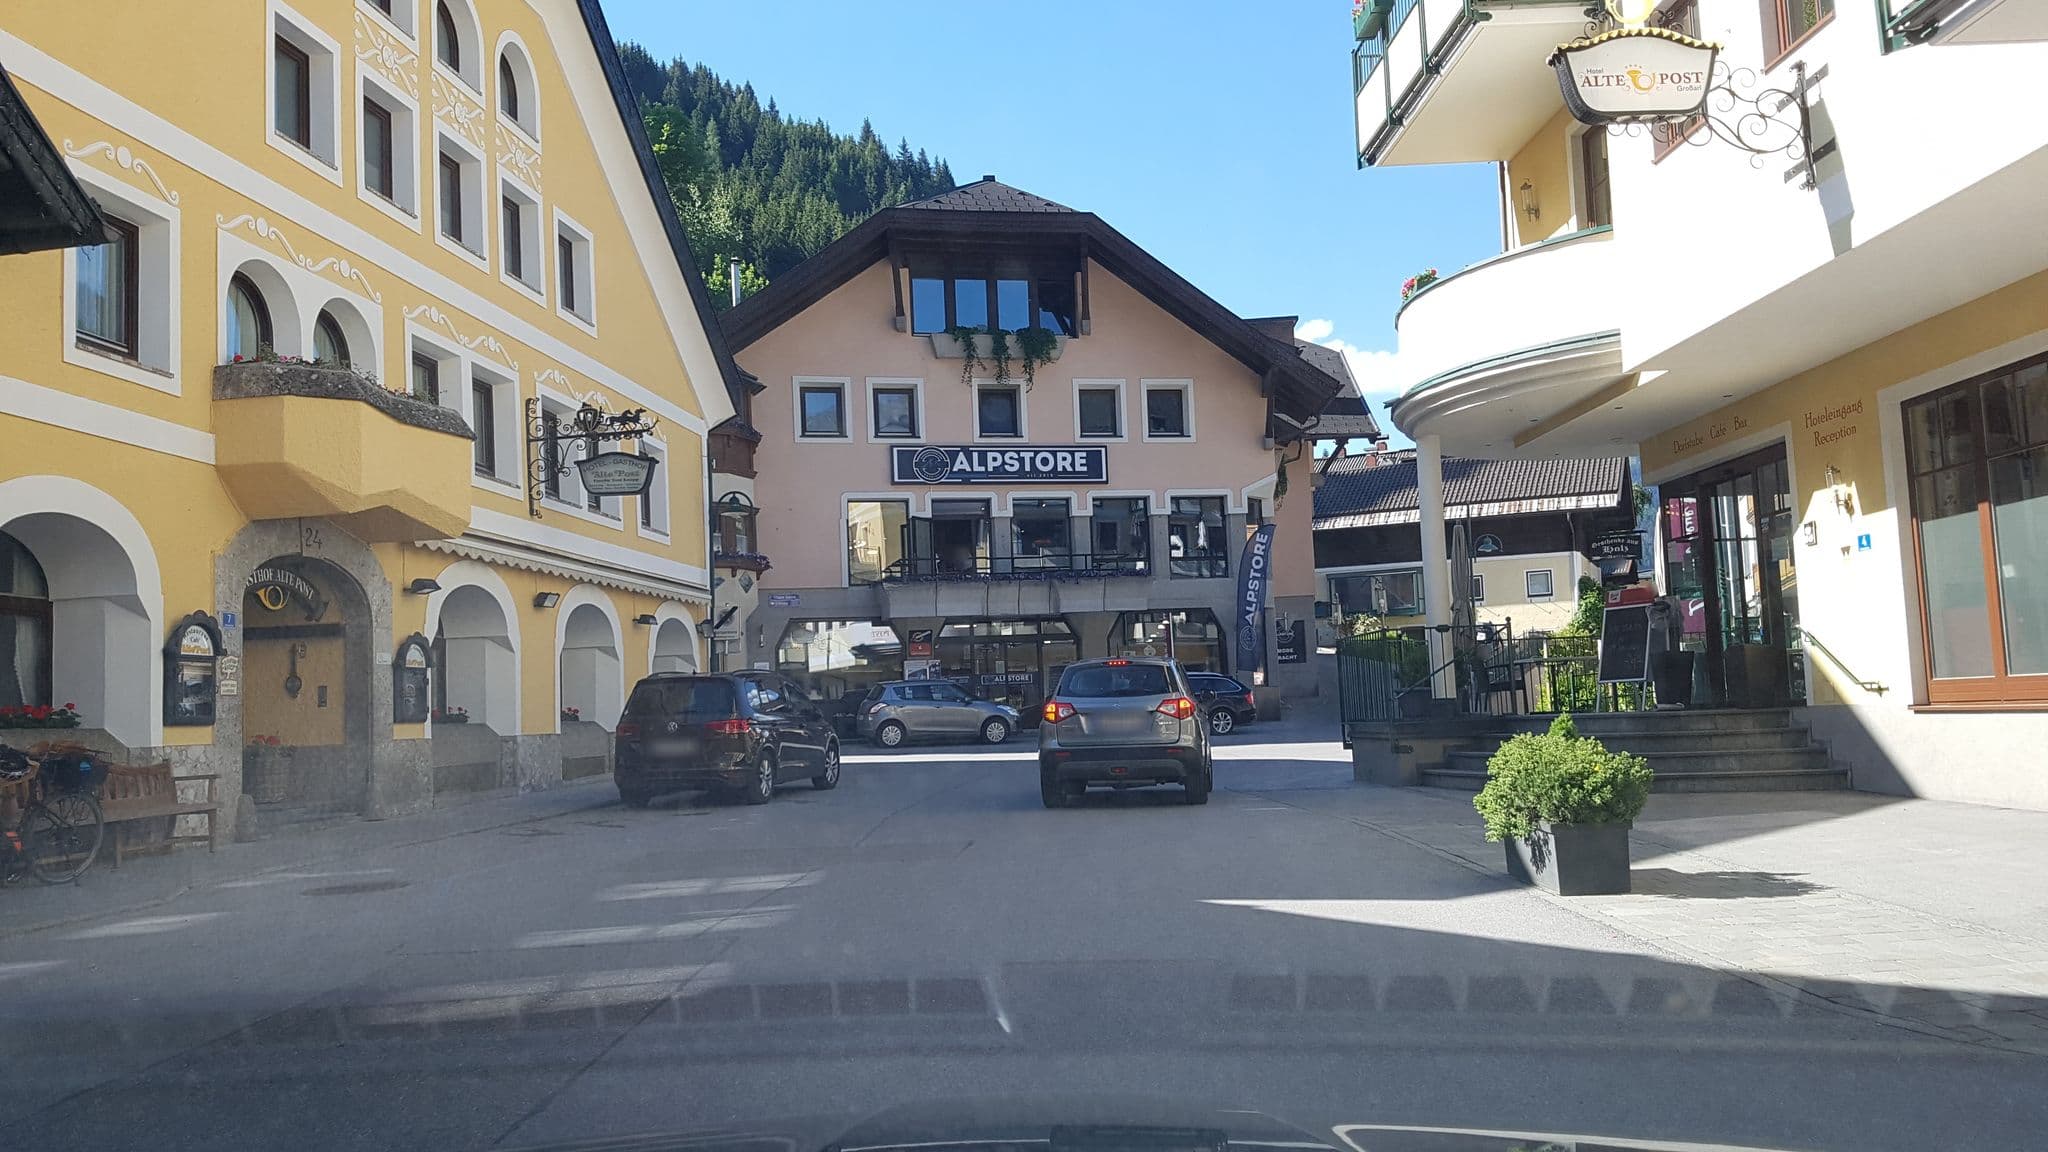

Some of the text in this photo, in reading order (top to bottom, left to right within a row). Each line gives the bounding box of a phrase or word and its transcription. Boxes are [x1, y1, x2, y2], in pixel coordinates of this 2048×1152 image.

[1581, 71, 1703, 88] ALTE POST
[1804, 399, 1864, 429] Hoteleingang
[1813, 424, 1857, 447] Reception
[952, 451, 1088, 472] ALPSTORE
[305, 527, 322, 549] 24
[276, 569, 295, 587] ALTE
[295, 577, 314, 600] POST
[1244, 532, 1268, 625] ALPSTORE
[226, 614, 232, 624] 7
